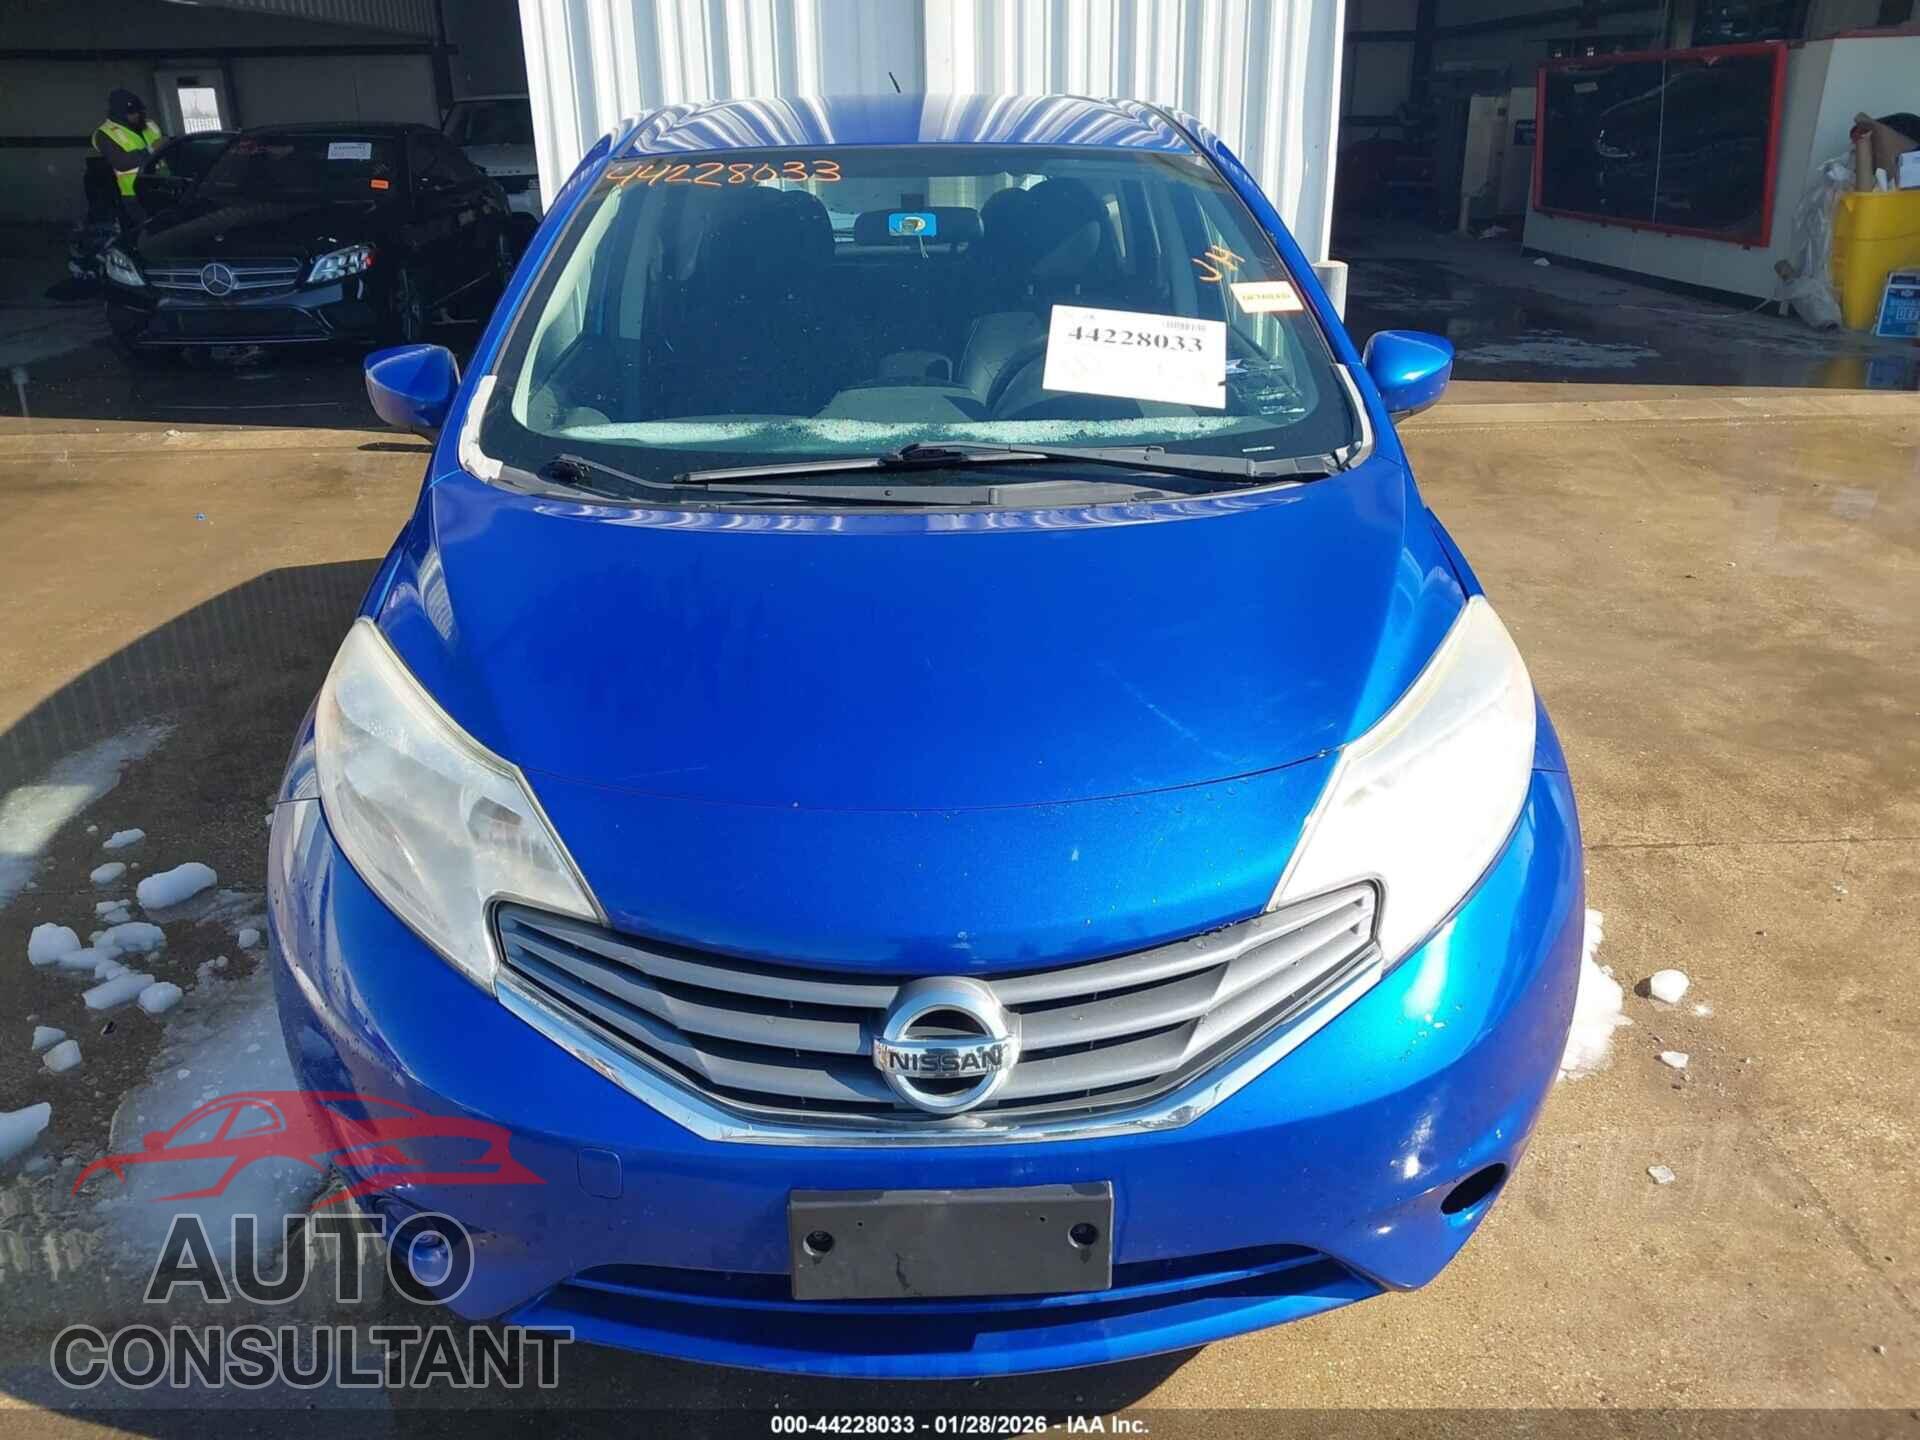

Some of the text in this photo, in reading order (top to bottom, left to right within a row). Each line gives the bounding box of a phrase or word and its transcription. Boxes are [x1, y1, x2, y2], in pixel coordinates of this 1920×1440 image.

[606, 160, 842, 187] 44228033
[1068, 325, 1203, 352] 44228033
[889, 1046, 1004, 1072] NISSAN
